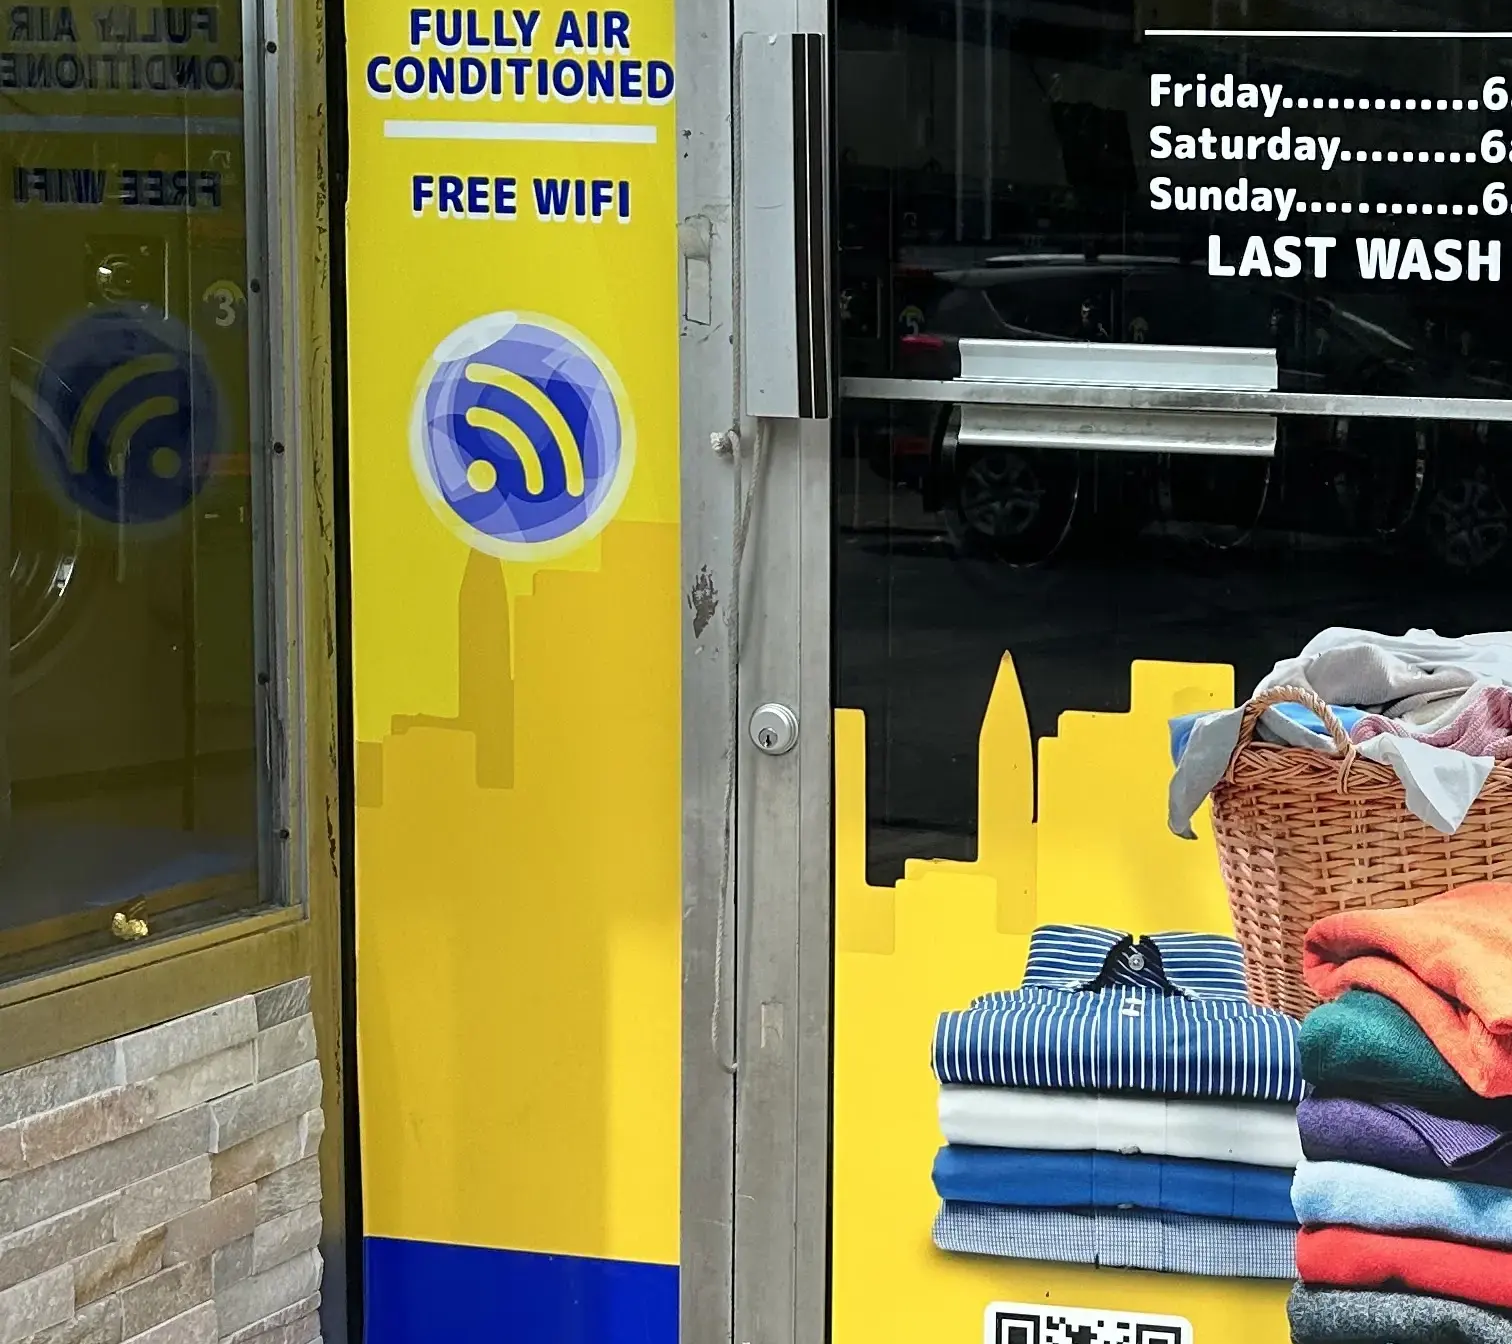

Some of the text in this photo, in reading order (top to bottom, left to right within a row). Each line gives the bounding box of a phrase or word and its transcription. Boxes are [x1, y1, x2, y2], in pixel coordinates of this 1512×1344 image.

[409, 8, 631, 54] FULLY AIR
[366, 56, 676, 104] CONDITIONED
[411, 175, 631, 223] FREE WIFI
[1208, 234, 1337, 278] LAST
[1355, 237, 1501, 282] WASH
[214, 288, 237, 328] 3
